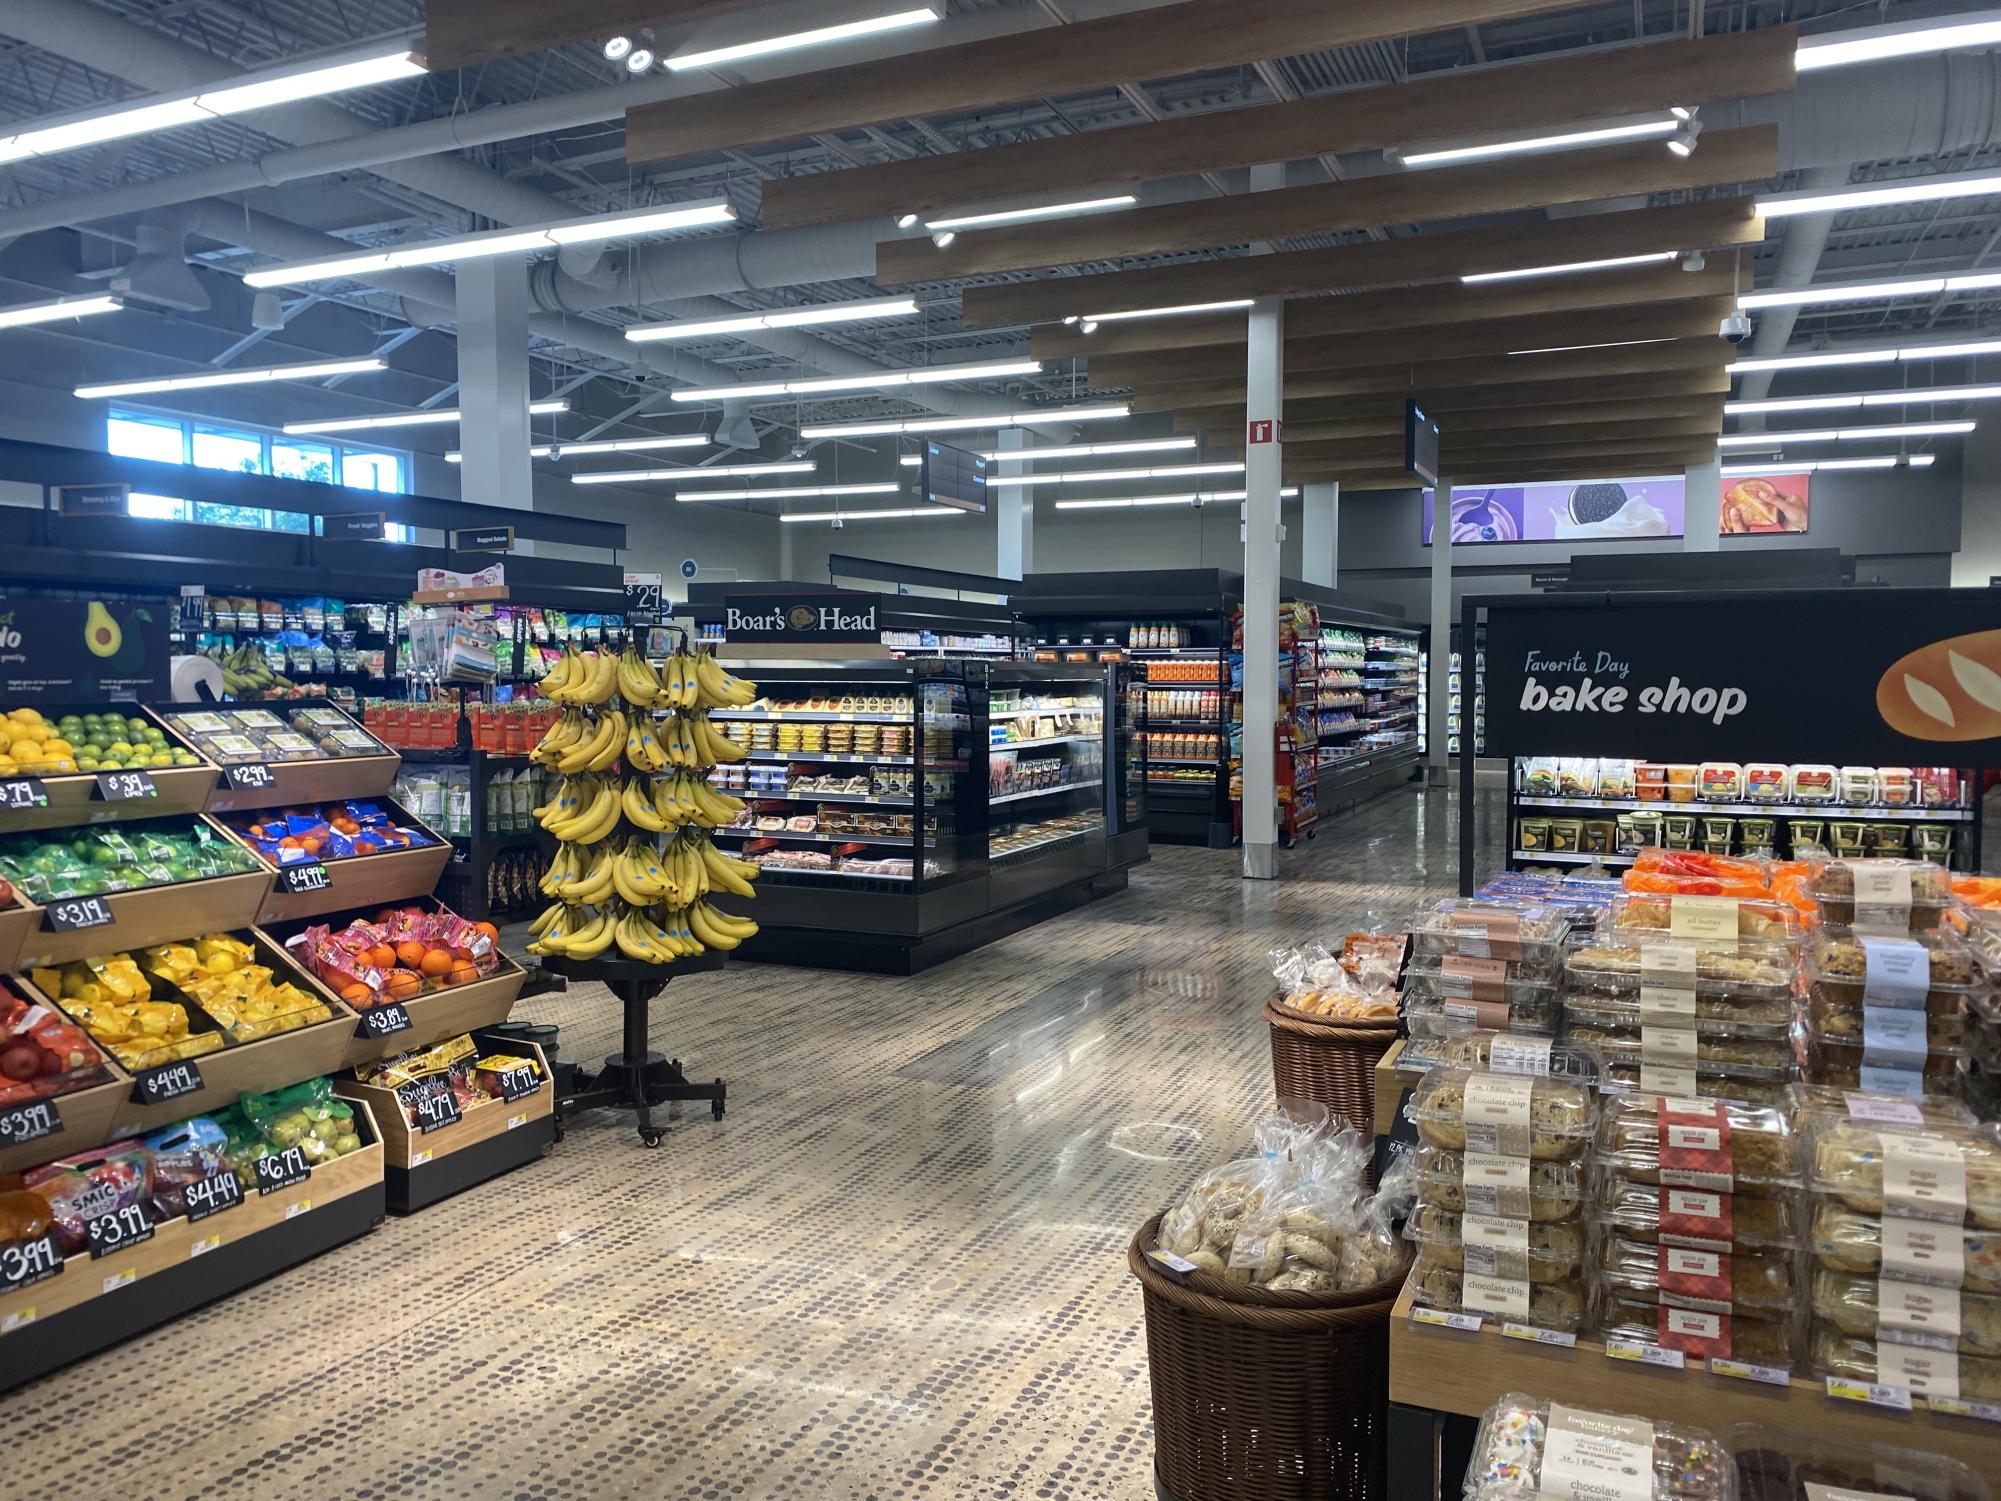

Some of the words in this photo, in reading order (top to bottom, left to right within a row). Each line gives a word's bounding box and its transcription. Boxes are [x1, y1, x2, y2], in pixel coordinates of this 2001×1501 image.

[387, 612, 395, 646] veggies
[726, 606, 786, 631] Boar's
[818, 606, 876, 631] Head
[1524, 650, 1588, 673] Favorite
[1594, 650, 1630, 680] Day
[1519, 676, 1629, 713] bake
[1637, 676, 1748, 726] shop
[289, 866, 323, 887] $4.99
[368, 1008, 401, 1029] $3.89
[147, 1065, 192, 1094] $4.49
[502, 1065, 534, 1092] $7.99
[418, 1092, 455, 1122] $4.79
[1468, 1096, 1507, 1106] chocolate
[1508, 1099, 1526, 1108] chip
[0, 1104, 51, 1135] $3.99
[259, 1147, 304, 1180] $6.79
[1468, 1157, 1507, 1167] chocolate
[1507, 1160, 1526, 1170] chip
[185, 1171, 239, 1208] $4.49
[83, 1198, 116, 1219] CRISP
[89, 1203, 146, 1244] $3.99
[1467, 1216, 1505, 1227] chocolate
[1506, 1220, 1525, 1231] chip
[0, 1237, 55, 1281] 3.99
[1467, 1281, 1507, 1293] chocolate
[1506, 1285, 1526, 1297] chip
[1570, 1480, 1622, 1498] chocolate
